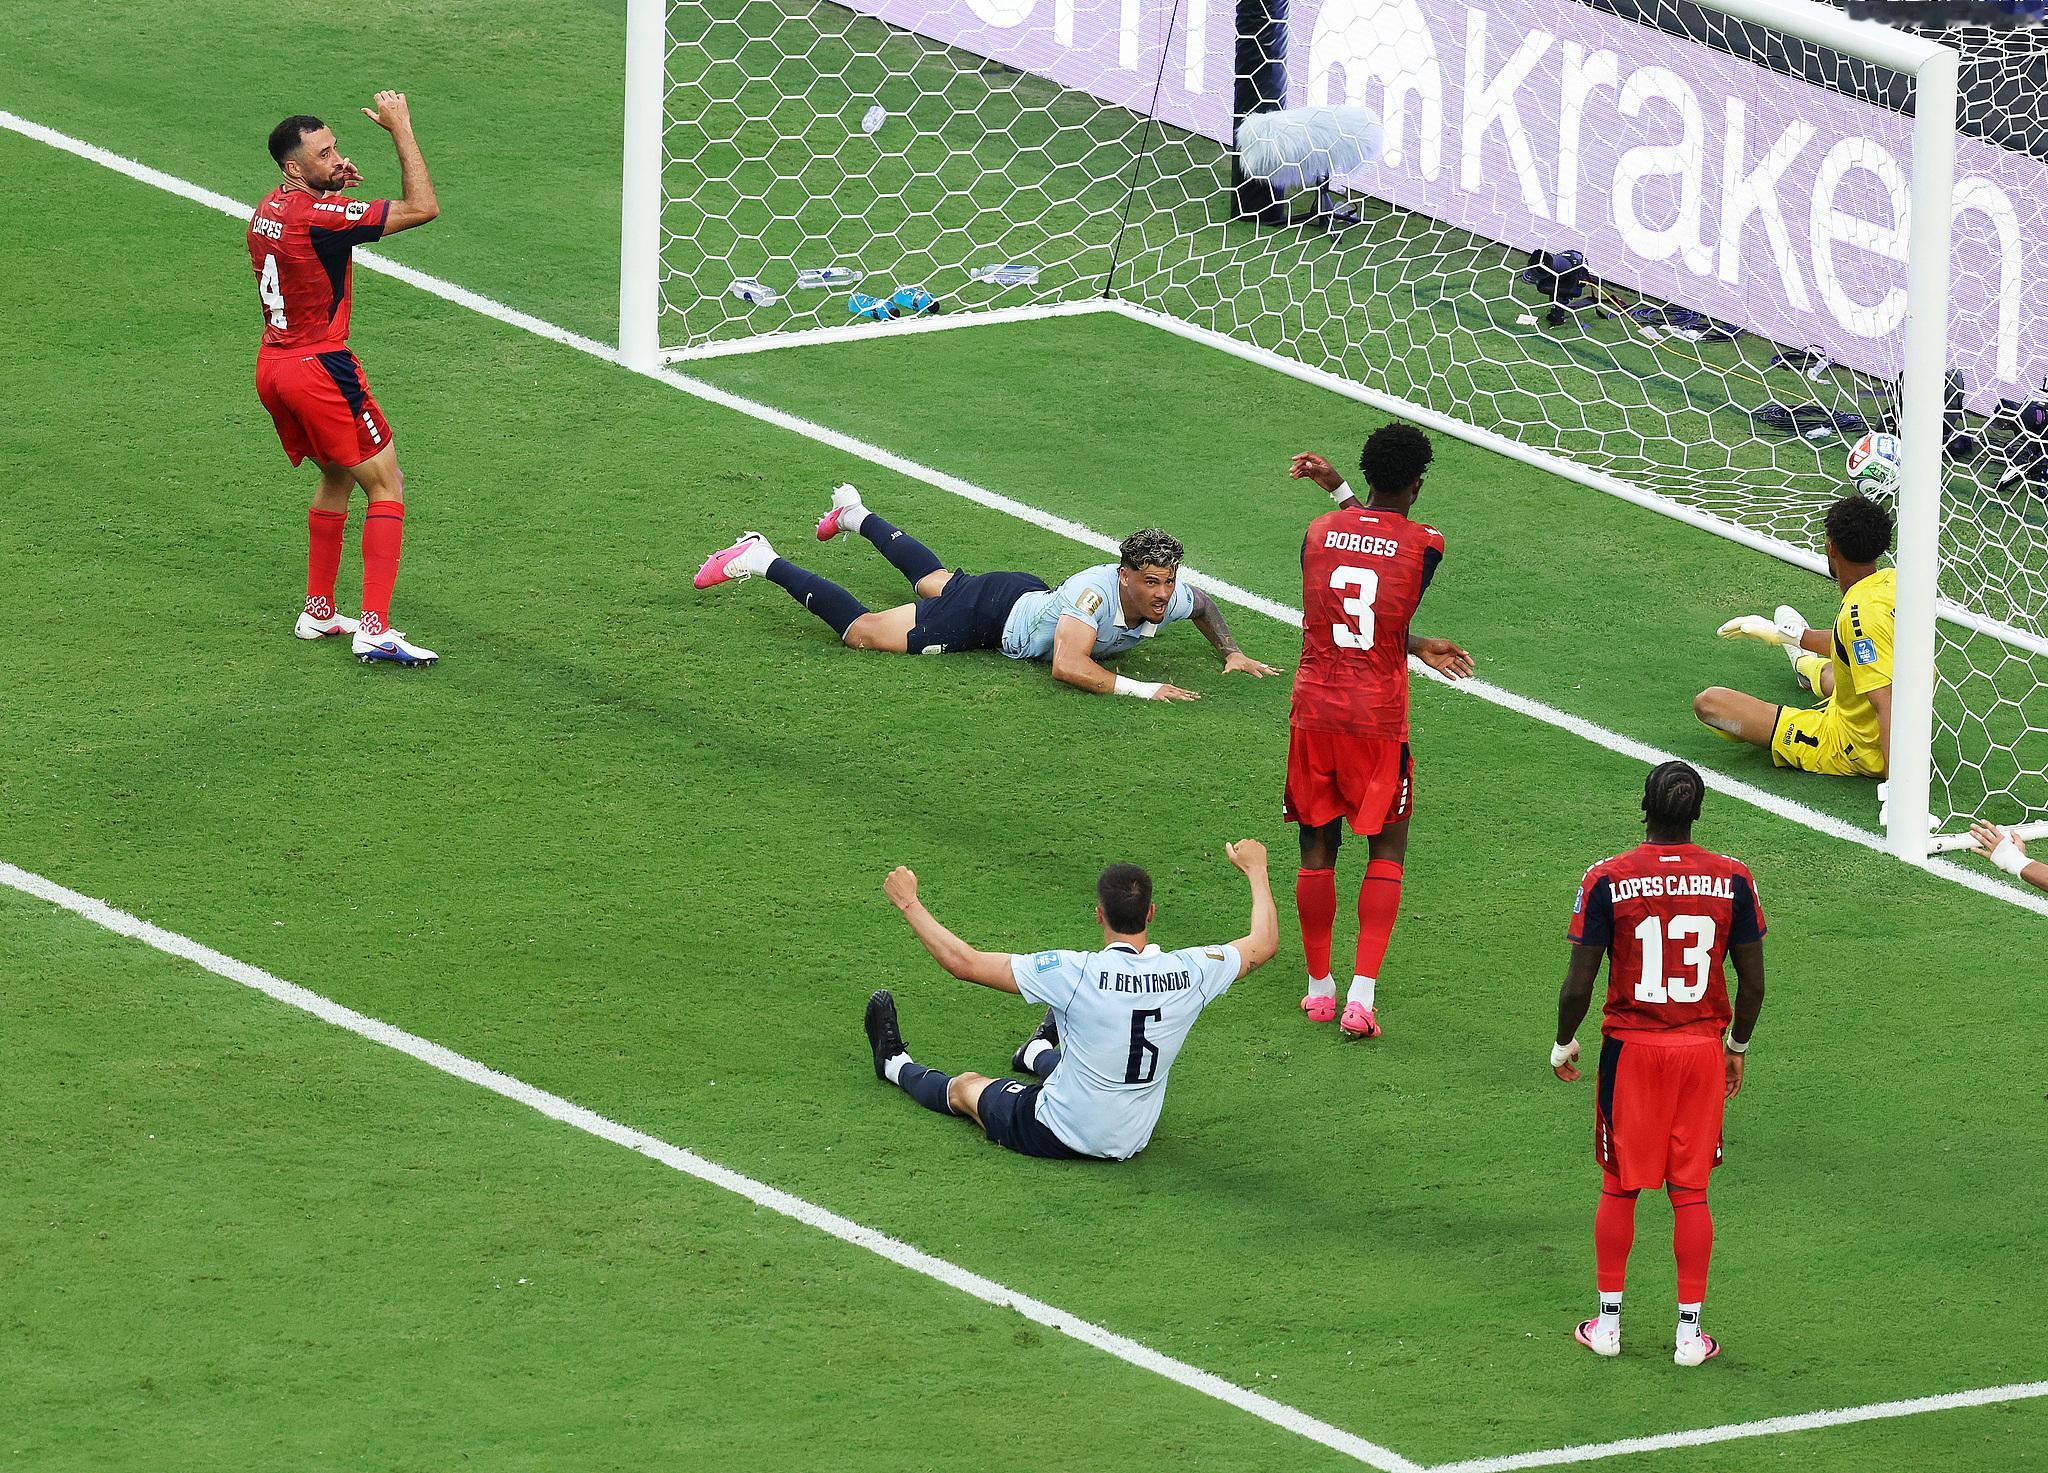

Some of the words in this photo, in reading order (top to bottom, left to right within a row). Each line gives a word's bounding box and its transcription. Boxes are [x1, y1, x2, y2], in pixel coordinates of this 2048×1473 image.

[252, 215, 283, 240] LOPES
[260, 253, 288, 330] 4
[1324, 530, 1399, 557] BORGES
[1329, 565, 1379, 651] 3
[1794, 730, 1819, 747] 1
[1608, 876, 1668, 903] LOPES
[1665, 875, 1735, 900] CABRAL
[1634, 914, 1716, 1004] 13
[1099, 971, 1112, 990] R.
[1124, 1008, 1162, 1084] 6
